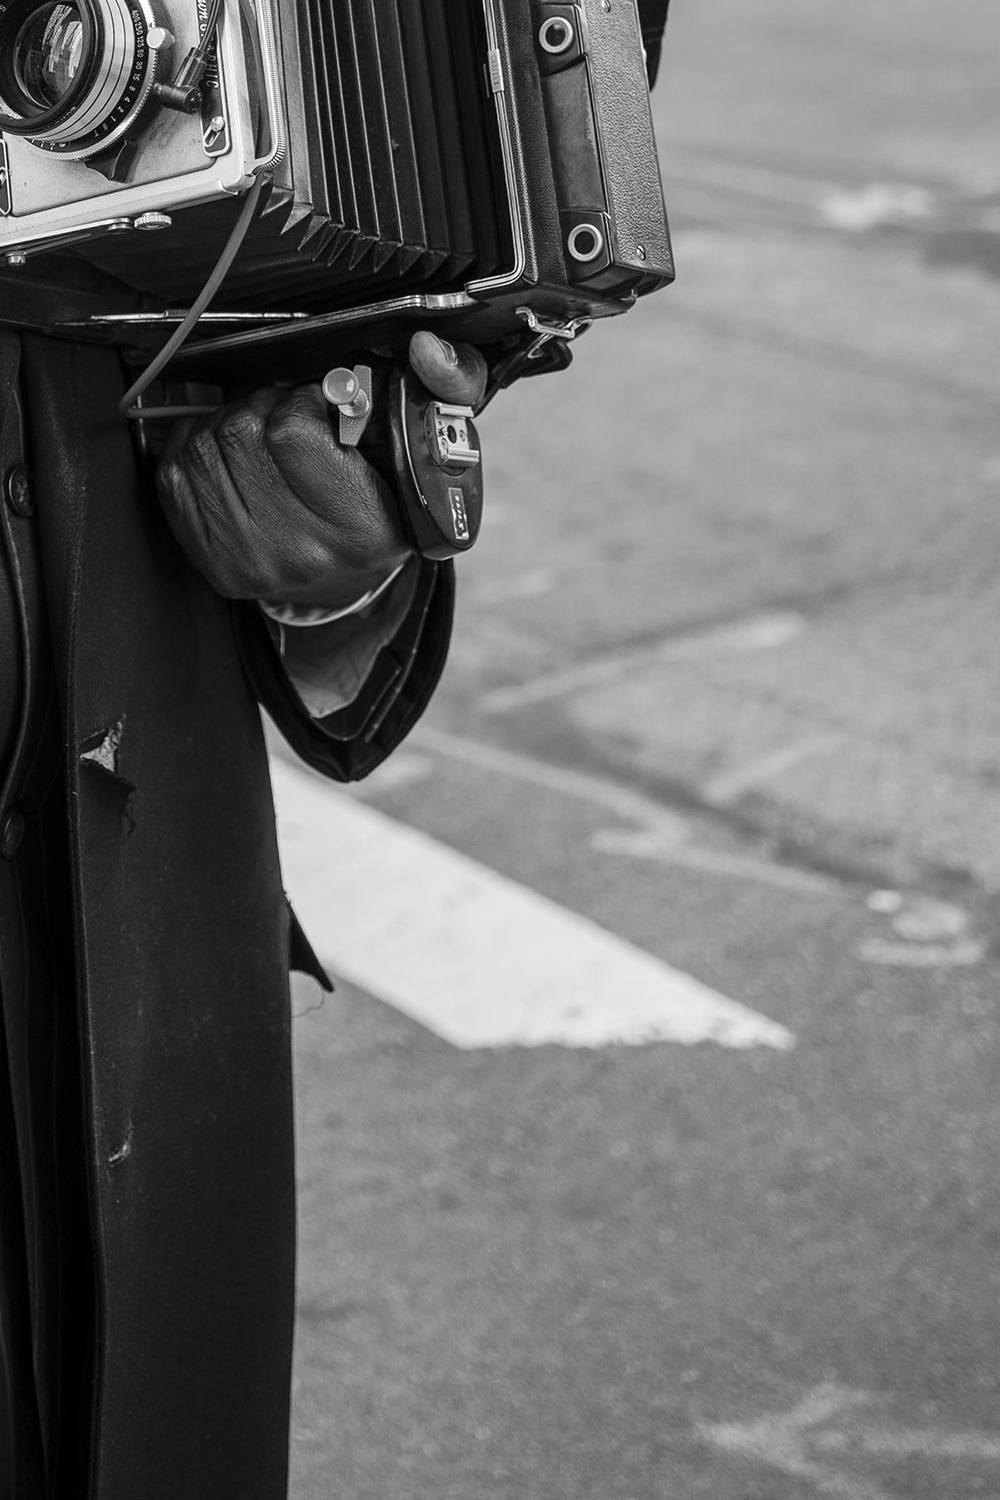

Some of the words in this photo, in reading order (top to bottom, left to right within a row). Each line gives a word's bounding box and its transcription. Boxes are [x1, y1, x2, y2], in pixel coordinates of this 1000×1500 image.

[134, 21, 144, 36] 250
[137, 36, 145, 48] 125
[135, 60, 143, 70] 30
[132, 73, 141, 81] 15
